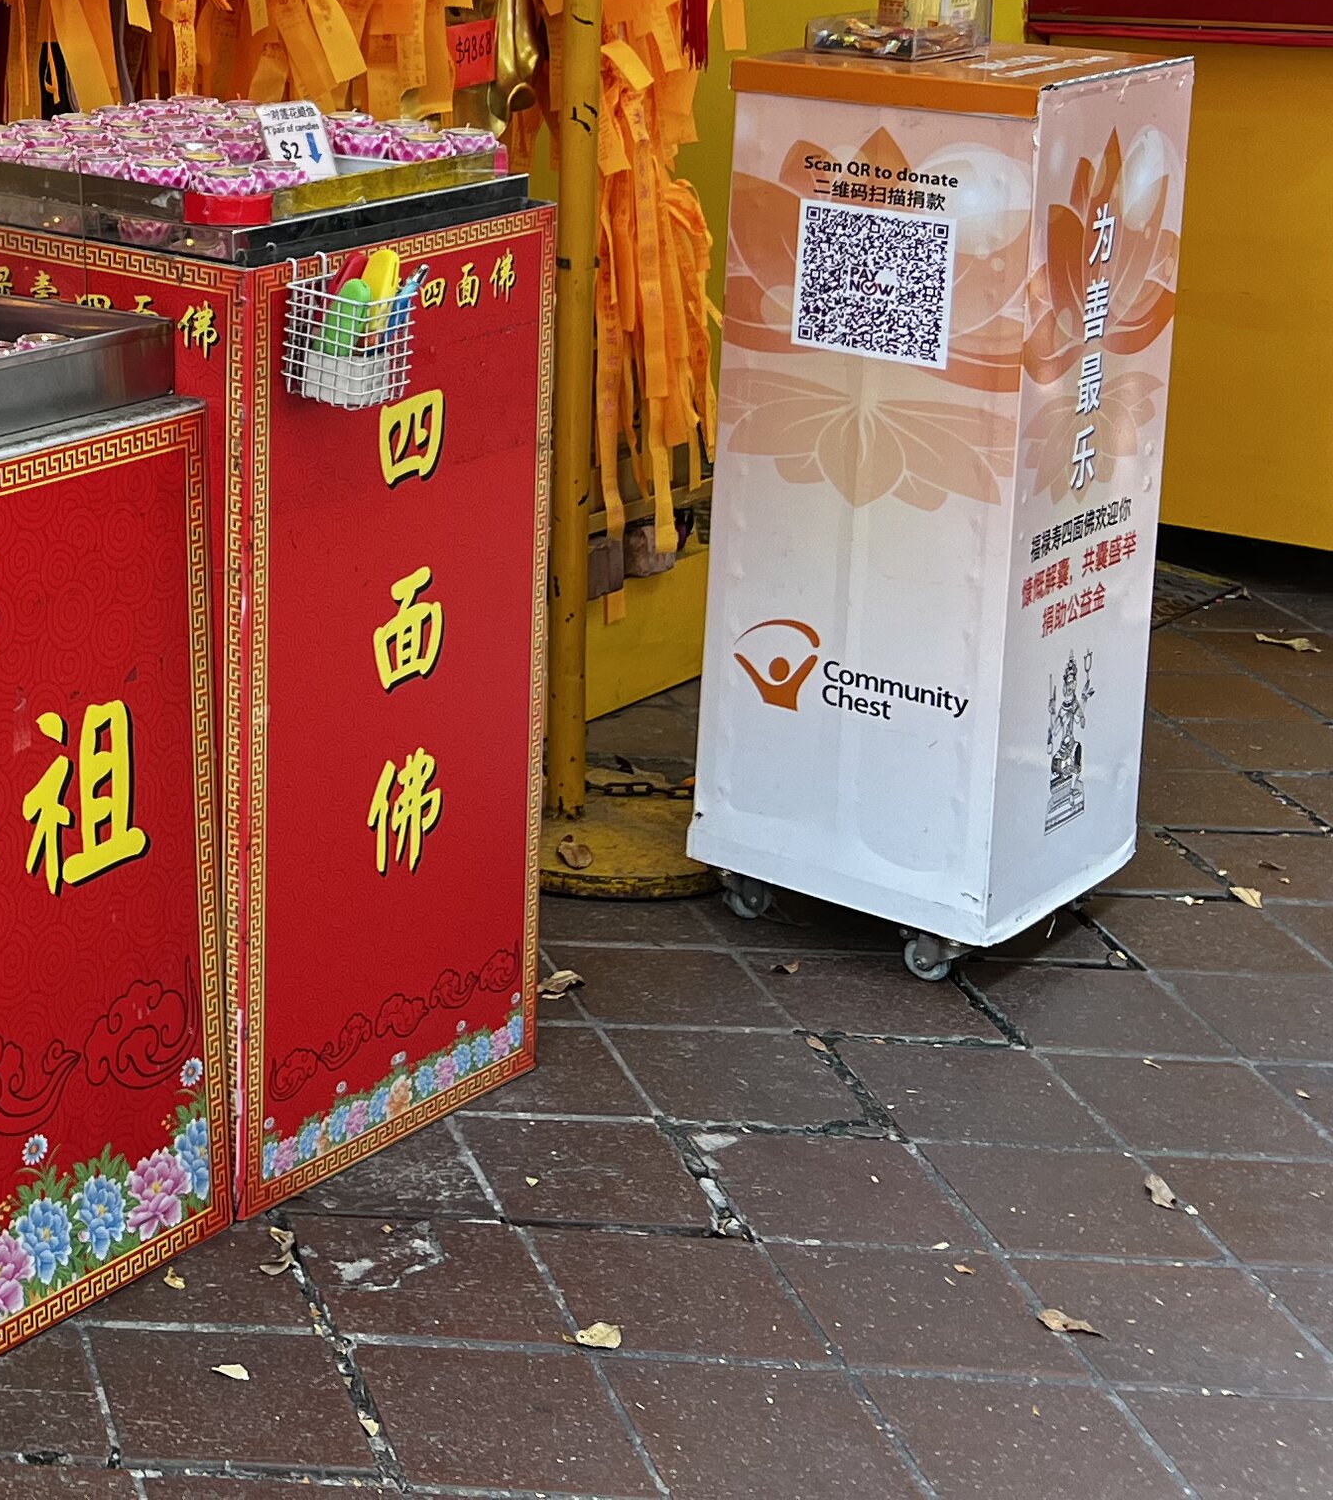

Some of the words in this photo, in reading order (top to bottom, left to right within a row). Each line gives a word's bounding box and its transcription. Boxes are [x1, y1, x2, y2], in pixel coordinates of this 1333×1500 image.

[455, 31, 493, 67] $9868
[279, 139, 303, 161] $2
[804, 155, 843, 173] Scan
[847, 161, 871, 178] QR
[874, 166, 893, 180] to
[896, 168, 959, 188] donate
[813, 178, 946, 212] 二维码扫描捐款
[849, 266, 878, 281] PAY
[1070, 202, 1116, 491] 为善最乐
[1041, 581, 1107, 639] 捐助公益金
[367, 388, 444, 876] 四面佛
[821, 684, 892, 721] Chest
[822, 659, 970, 720] Community
